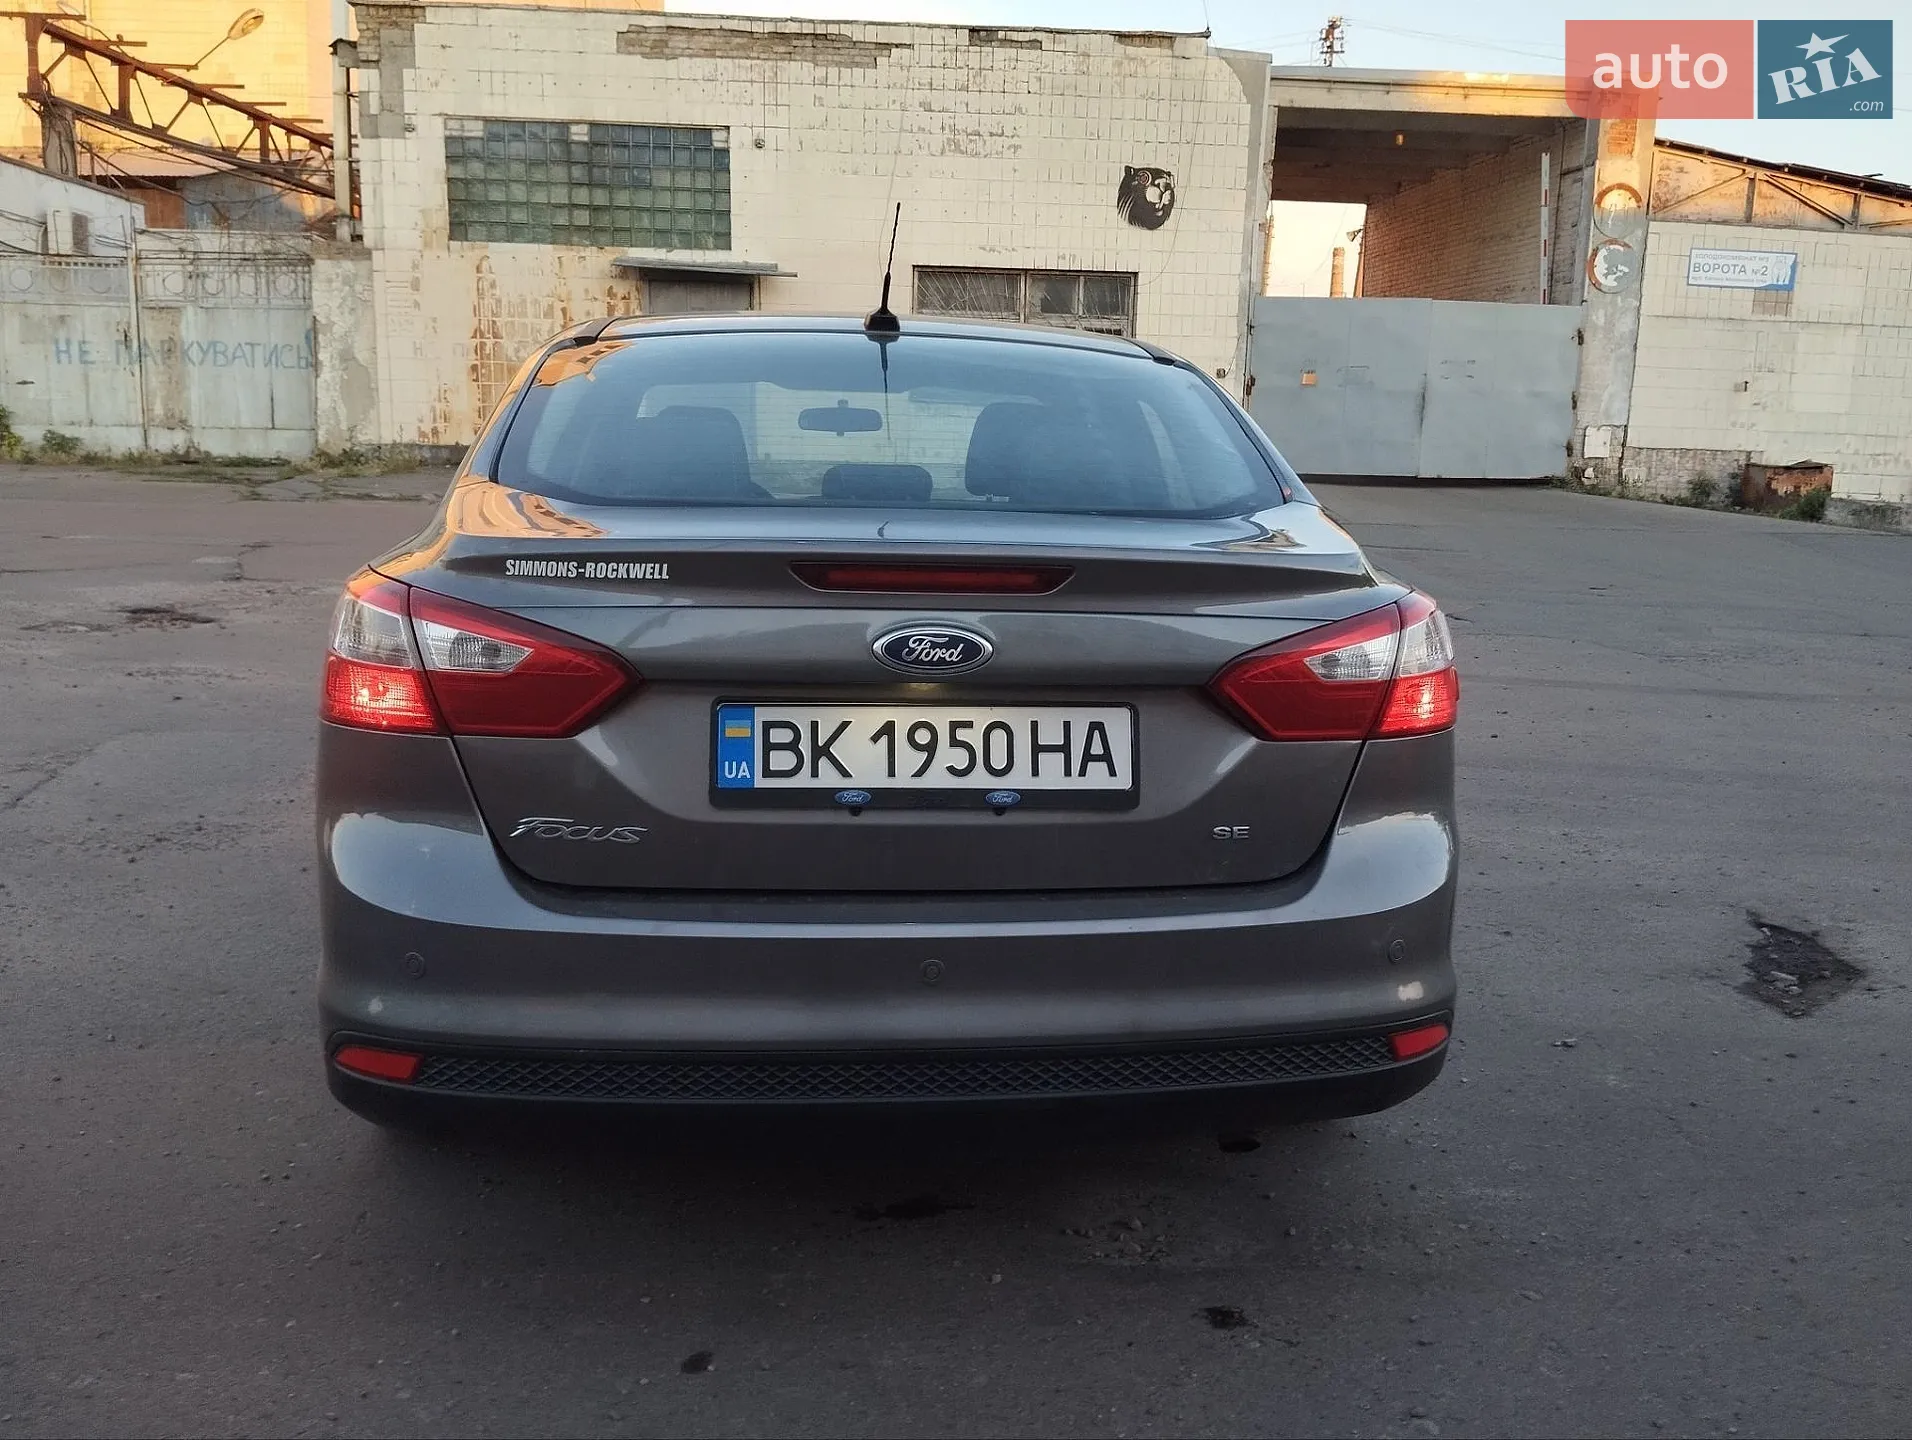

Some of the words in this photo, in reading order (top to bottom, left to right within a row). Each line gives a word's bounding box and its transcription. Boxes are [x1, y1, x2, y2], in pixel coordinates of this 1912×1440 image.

[1693, 262, 1747, 275] ВОРОТА
[54, 337, 97, 365] НЕ
[505, 559, 669, 580] SIMMONS-ROCKWELL
[901, 635, 964, 662] Ford
[761, 720, 853, 778] BK
[869, 720, 1014, 778] 1950
[1031, 720, 1117, 778] HA
[724, 761, 751, 779] UA
[841, 791, 863, 803] Ford
[991, 792, 1013, 804] Ford
[1212, 825, 1251, 840] SE
